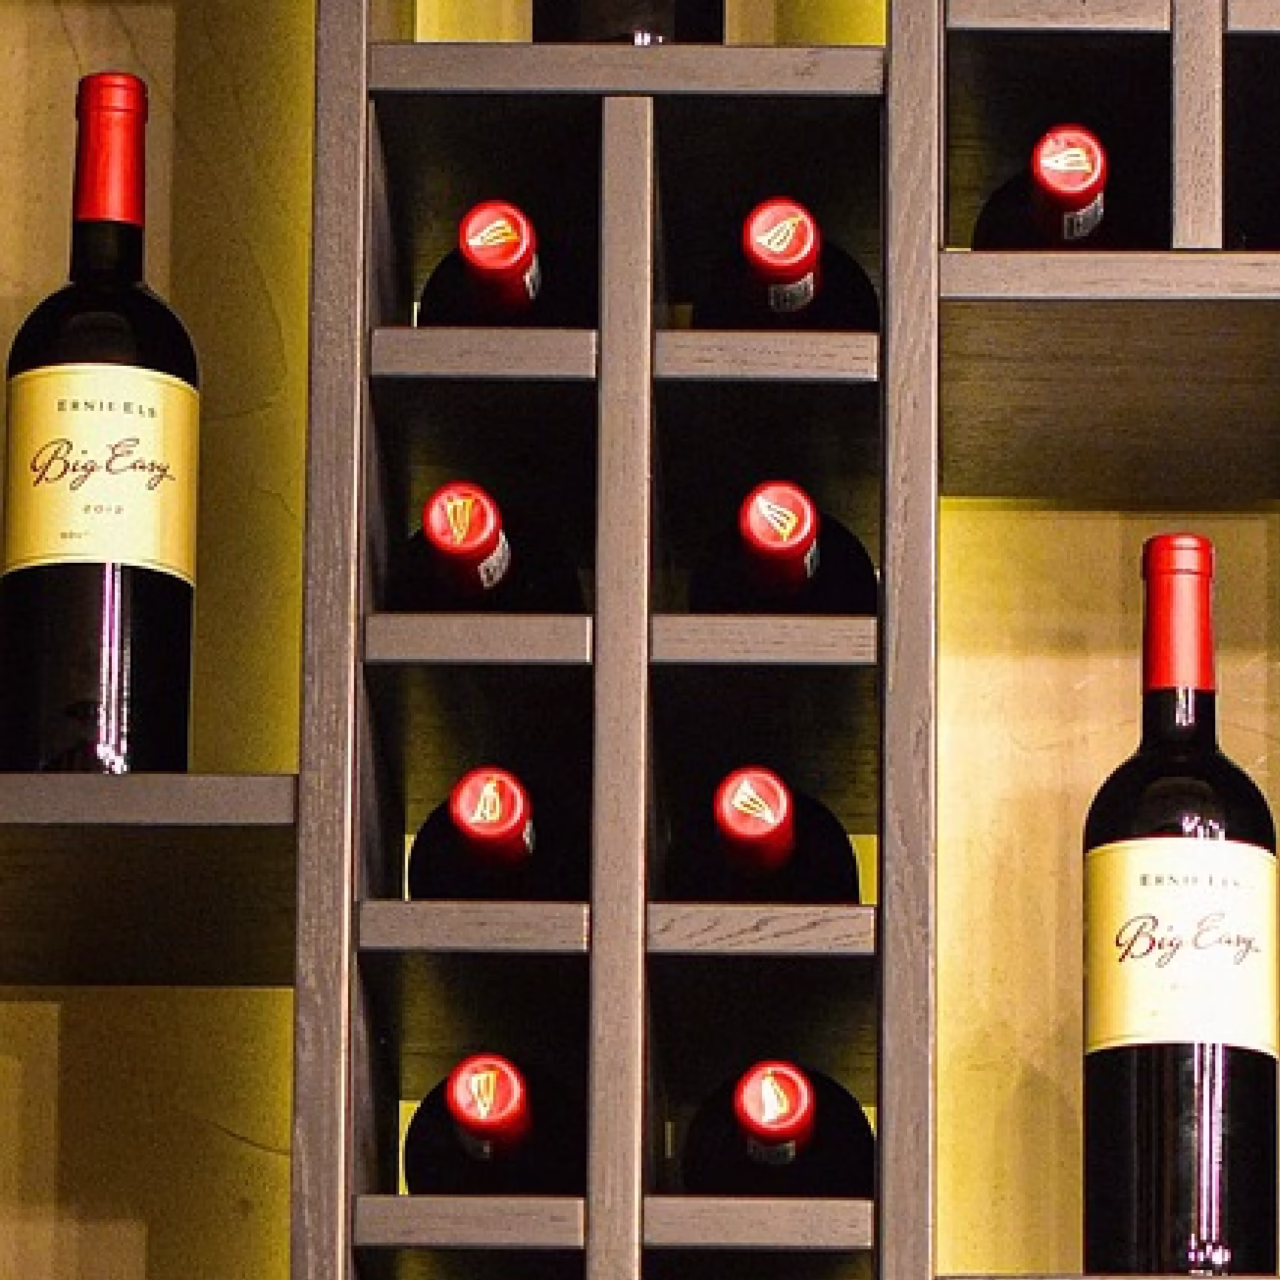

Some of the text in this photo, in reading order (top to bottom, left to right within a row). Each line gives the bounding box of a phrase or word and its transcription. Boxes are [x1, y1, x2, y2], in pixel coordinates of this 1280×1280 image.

[30, 438, 176, 491] Big Easy
[1115, 913, 1261, 968] Big Easy
